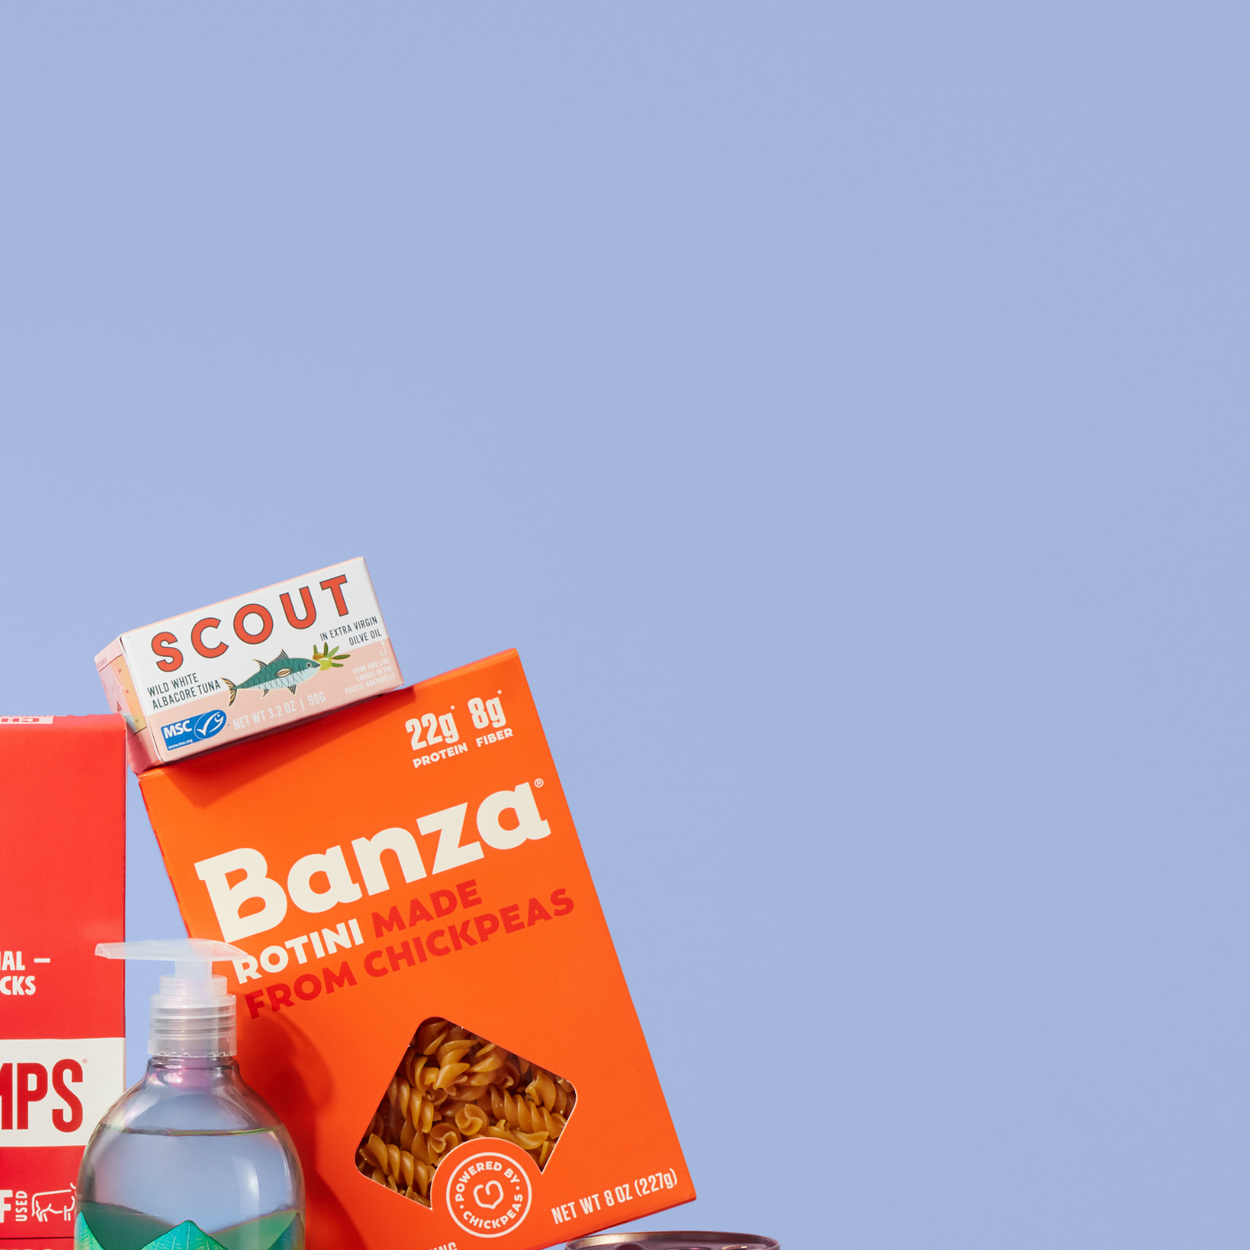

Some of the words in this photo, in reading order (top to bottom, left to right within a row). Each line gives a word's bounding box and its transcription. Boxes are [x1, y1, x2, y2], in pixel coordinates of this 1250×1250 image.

[151, 574, 349, 672] SCOUT
[320, 633, 329, 642] IN
[330, 625, 353, 639] EXTRA
[353, 616, 378, 630] VIRGIN
[370, 629, 382, 639] OIL
[147, 683, 170, 697] WILD
[171, 673, 199, 689] WHITE
[152, 687, 197, 710] ALBACORE
[197, 680, 221, 695] TUNA
[163, 720, 193, 739] MSC
[233, 716, 250, 731] NET
[251, 711, 266, 726] WT
[268, 705, 284, 721] 3.2
[285, 701, 298, 716] OZ
[308, 691, 327, 708] 90G
[413, 743, 468, 769] PROTEIN
[476, 728, 514, 748] FIBER
[195, 780, 551, 943] Banza
[232, 919, 365, 984] ROTINI
[371, 879, 483, 939] MADE
[244, 961, 358, 1020] FROM
[364, 888, 575, 978] CHICKPEAS
[455, 1161, 503, 1201] POWERED
[503, 1167, 521, 1186] BY
[551, 1202, 577, 1225] NET
[579, 1193, 601, 1216] WT
[603, 1190, 614, 1206] 8
[615, 1184, 634, 1203] OZ
[634, 1168, 679, 1198] (227g)
[15, 1190, 28, 1222] USED
[461, 1193, 524, 1230] CHICKPEAS
